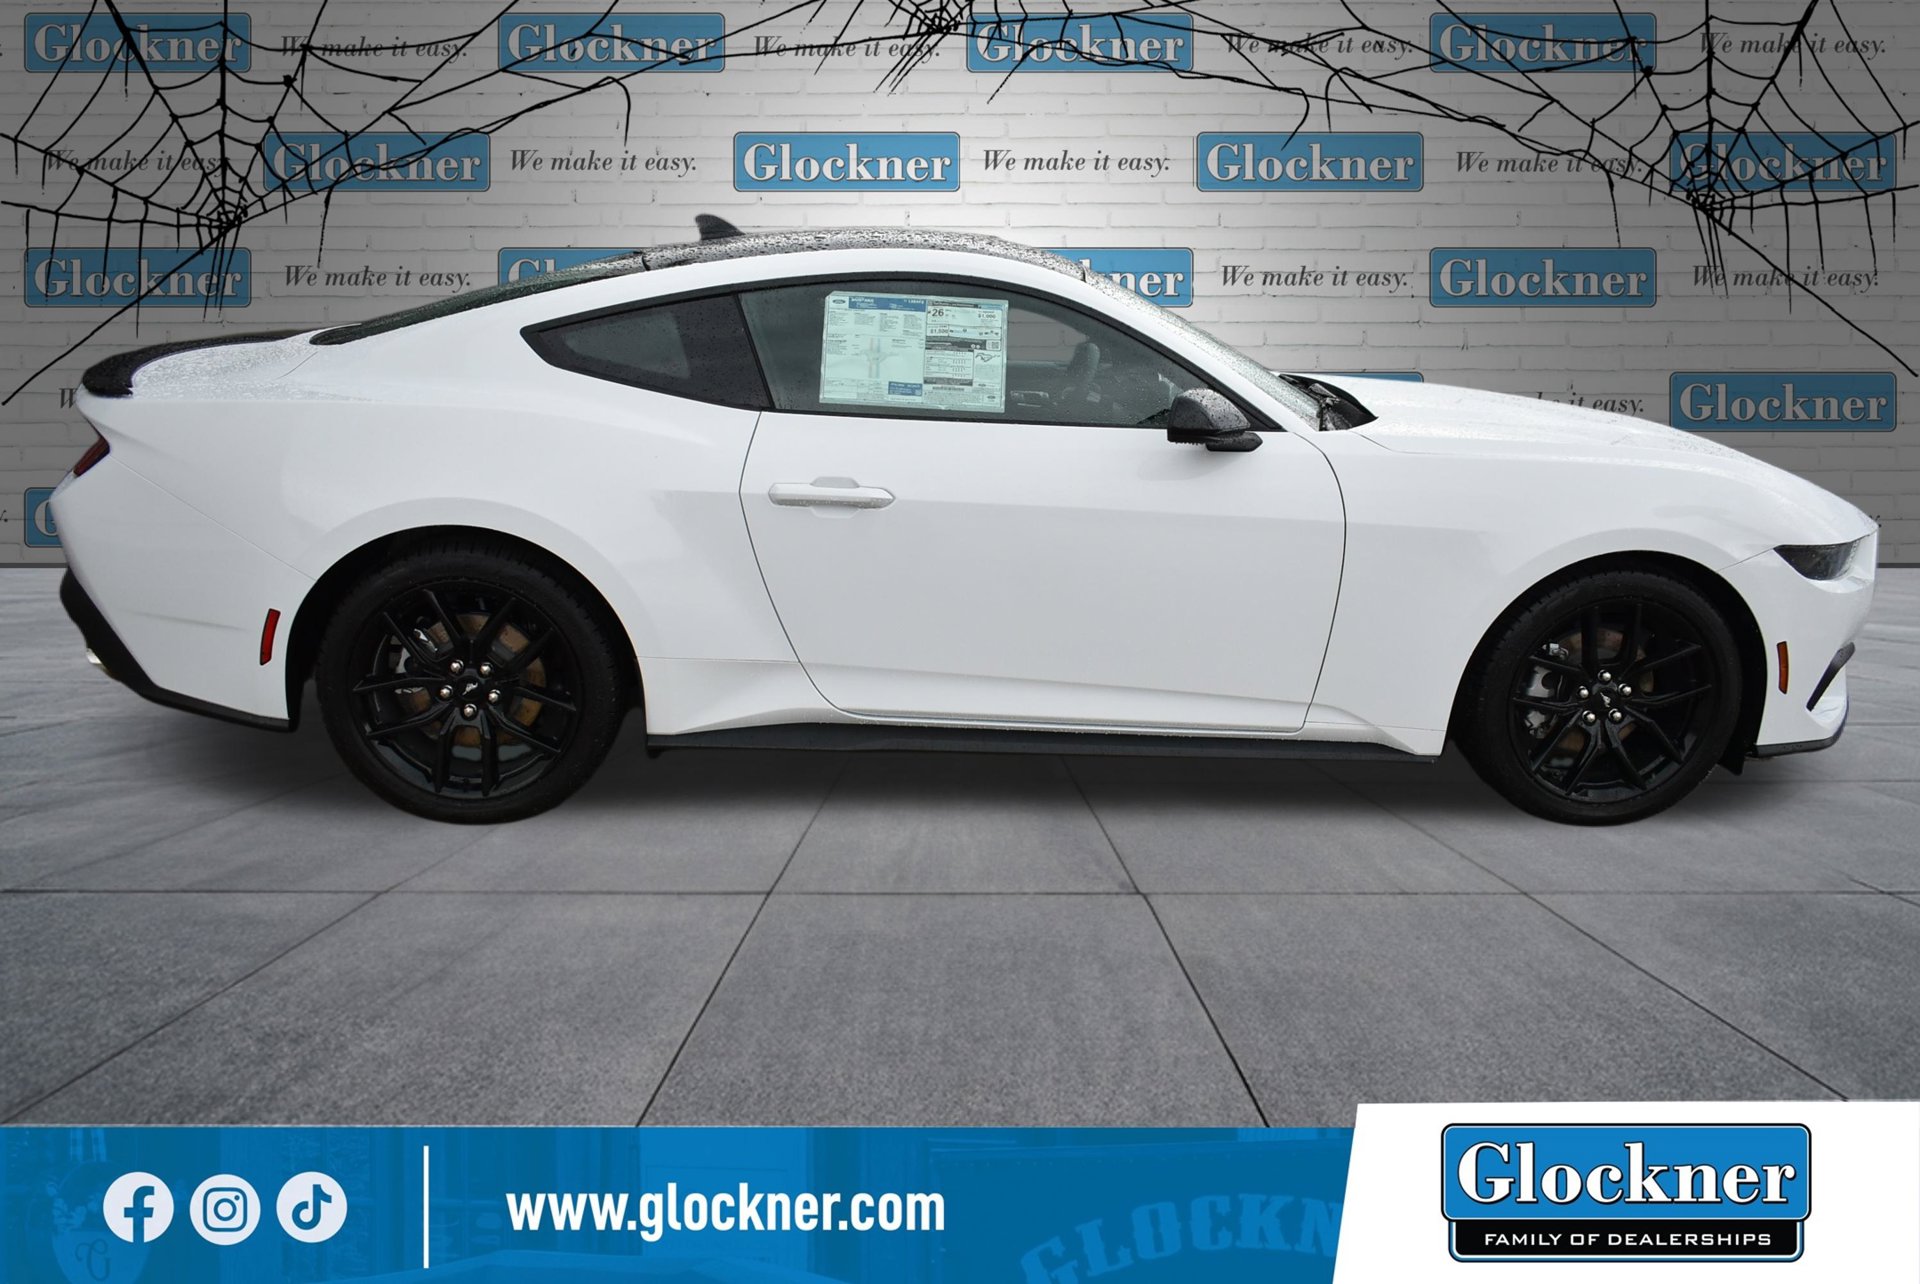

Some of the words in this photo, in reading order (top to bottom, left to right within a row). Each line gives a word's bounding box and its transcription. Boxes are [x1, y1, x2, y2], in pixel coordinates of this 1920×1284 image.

[33, 24, 243, 63] Glockner
[321, 35, 385, 57] make
[393, 35, 410, 57] it
[416, 42, 468, 63] easy.
[507, 24, 716, 63] Glockner
[754, 36, 788, 58] We
[795, 36, 857, 58] make
[863, 36, 880, 58] it
[889, 43, 940, 64] easy.
[977, 24, 1185, 63] Glockner
[1225, 34, 1260, 56] We
[1336, 34, 1353, 56] it
[1360, 41, 1414, 62] easy.
[1439, 24, 1650, 63] Glockner
[1700, 33, 1732, 55] We
[1811, 33, 1826, 55] it
[1834, 40, 1886, 61] easy.
[47, 150, 77, 172] We
[83, 150, 147, 172] make
[157, 150, 173, 172] it
[272, 143, 482, 182] Glockner
[510, 150, 541, 172] We
[549, 150, 614, 172] make
[621, 150, 638, 172] it
[645, 157, 696, 178] easy.
[743, 143, 951, 182] Glockner
[983, 150, 1016, 172] We
[1024, 150, 1087, 172] make
[1095, 150, 1110, 172] it
[1118, 157, 1170, 178] easy.
[1206, 143, 1416, 182] Glockner
[1456, 151, 1488, 173] We
[1496, 151, 1559, 173] make
[1567, 151, 1583, 173] it
[1679, 143, 1888, 182] Glockner
[33, 259, 243, 298] Glockner
[285, 265, 316, 287] We
[325, 265, 388, 287] make
[395, 265, 411, 287] it
[419, 272, 471, 293] easy.
[1222, 265, 1253, 287] We
[1263, 265, 1323, 287] make
[1331, 265, 1348, 287] it
[1356, 272, 1408, 293] easy.
[1440, 259, 1647, 297] Glockner
[1693, 265, 1725, 287] We
[1734, 265, 1795, 287] make
[1803, 265, 1819, 287] it
[1826, 272, 1878, 293] easy.
[1679, 383, 1887, 422] Glockner
